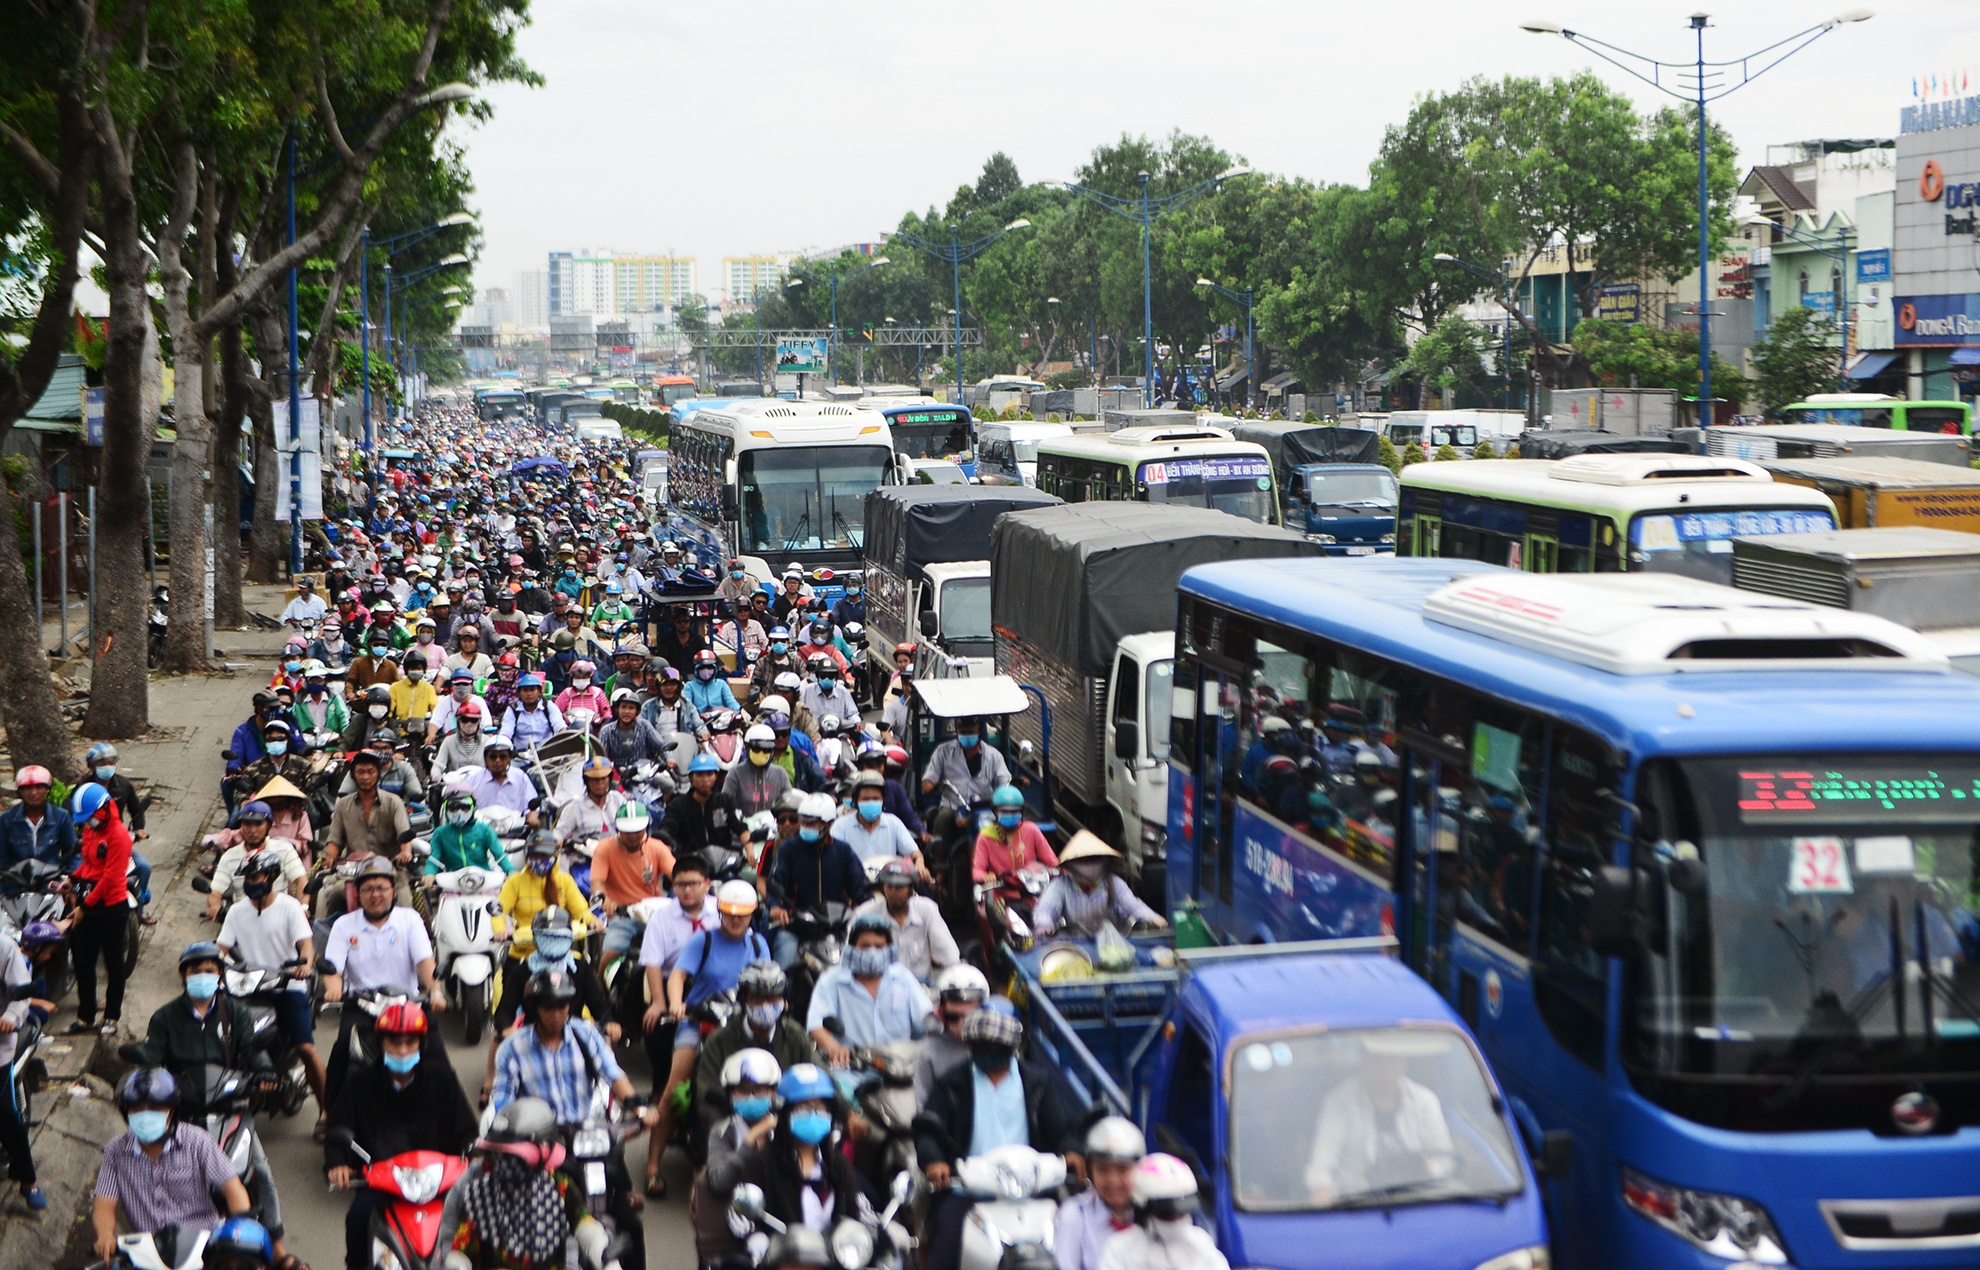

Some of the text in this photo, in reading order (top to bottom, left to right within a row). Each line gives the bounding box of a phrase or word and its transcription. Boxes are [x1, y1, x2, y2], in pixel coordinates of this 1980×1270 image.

[782, 340, 816, 349] TIFFY
[949, 455, 961, 463] 104
[1147, 465, 1165, 483] 04
[1167, 462, 1181, 477] BẾN
[1202, 465, 1217, 478] CỘNG
[1234, 465, 1242, 476] BX
[1243, 465, 1251, 476] AN
[1802, 839, 1840, 887] 32
